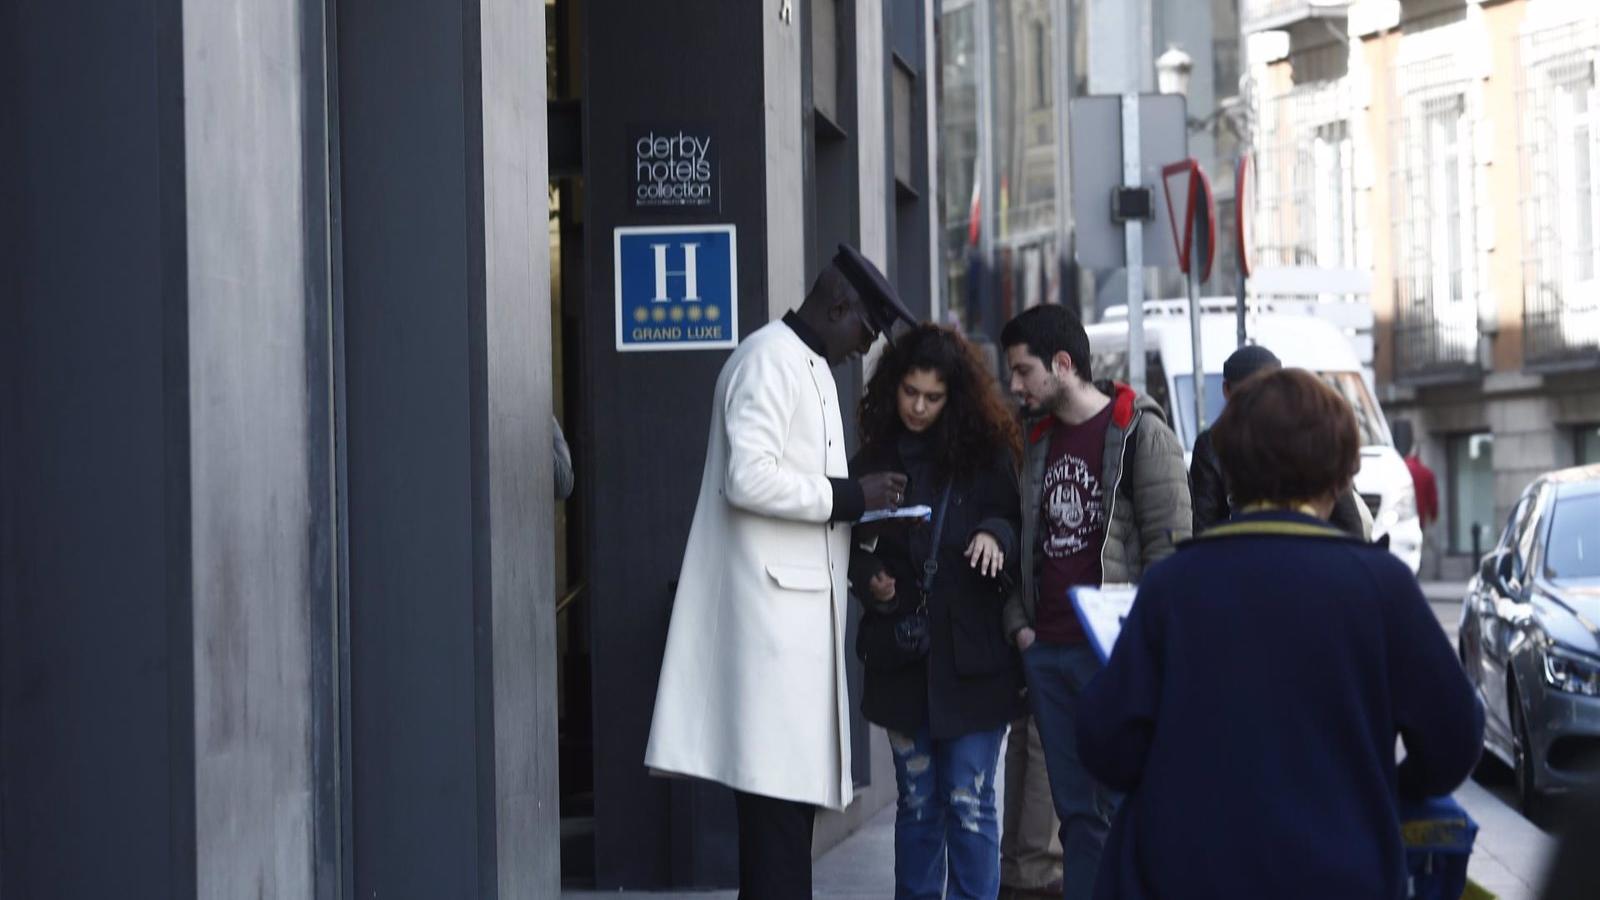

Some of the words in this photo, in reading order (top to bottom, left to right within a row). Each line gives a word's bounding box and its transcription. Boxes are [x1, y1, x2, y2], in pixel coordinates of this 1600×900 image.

[637, 130, 710, 160] derby
[637, 156, 710, 181] hotels
[637, 180, 711, 199] collection
[650, 242, 702, 302] H
[632, 327, 682, 341] GRAND
[687, 325, 722, 339] LUXE
